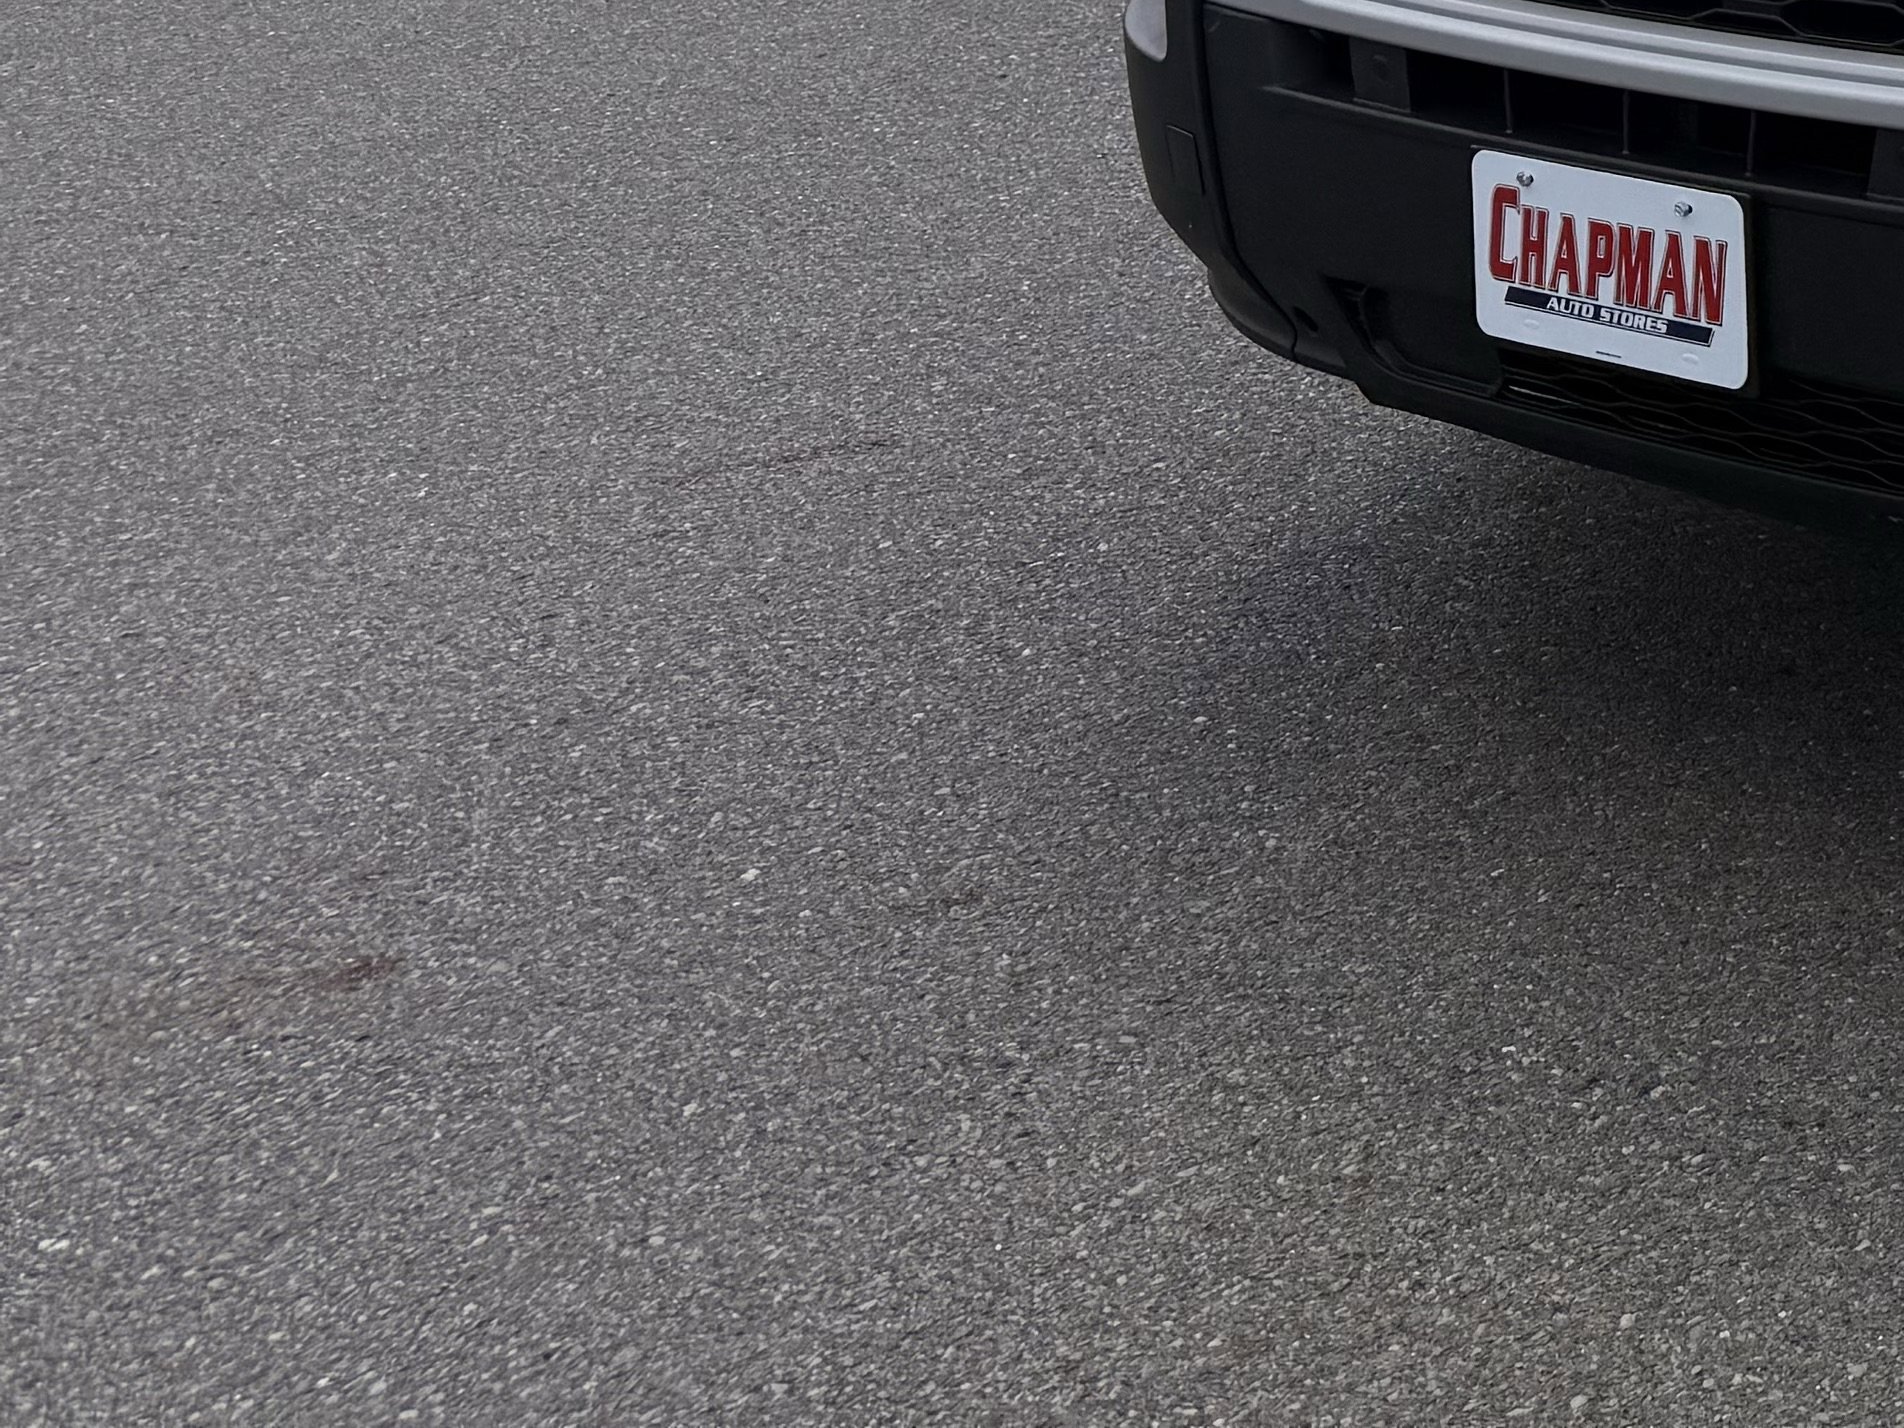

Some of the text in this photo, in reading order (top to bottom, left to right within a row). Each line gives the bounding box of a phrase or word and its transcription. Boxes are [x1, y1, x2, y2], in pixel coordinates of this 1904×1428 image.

[1488, 183, 1729, 327] CHAPMAN
[1546, 296, 1669, 333] AUTO STORES
